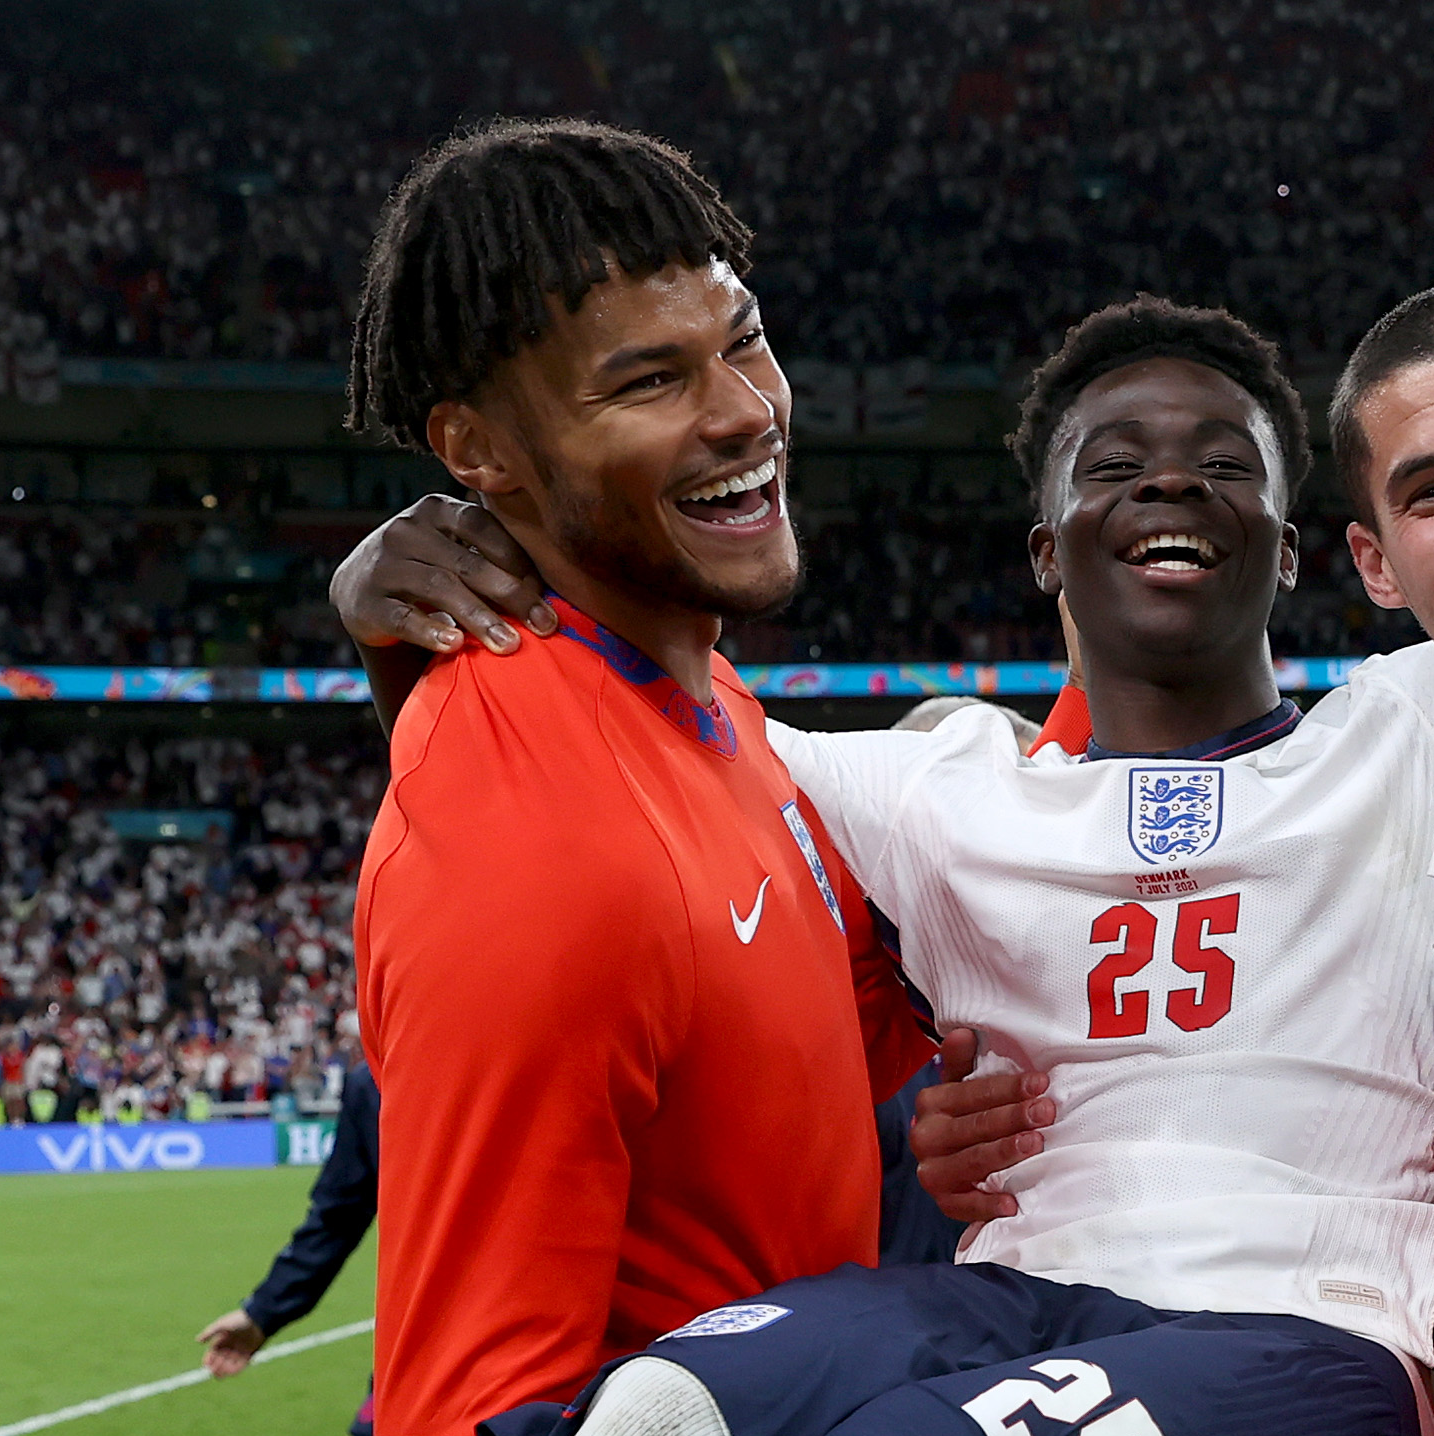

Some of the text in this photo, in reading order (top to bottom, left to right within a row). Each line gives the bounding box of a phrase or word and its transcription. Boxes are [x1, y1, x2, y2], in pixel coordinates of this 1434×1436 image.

[1135, 868, 1190, 884] DENMARK
[1136, 880, 1199, 895] 7 JULY 2021
[1087, 892, 1241, 1039] 25
